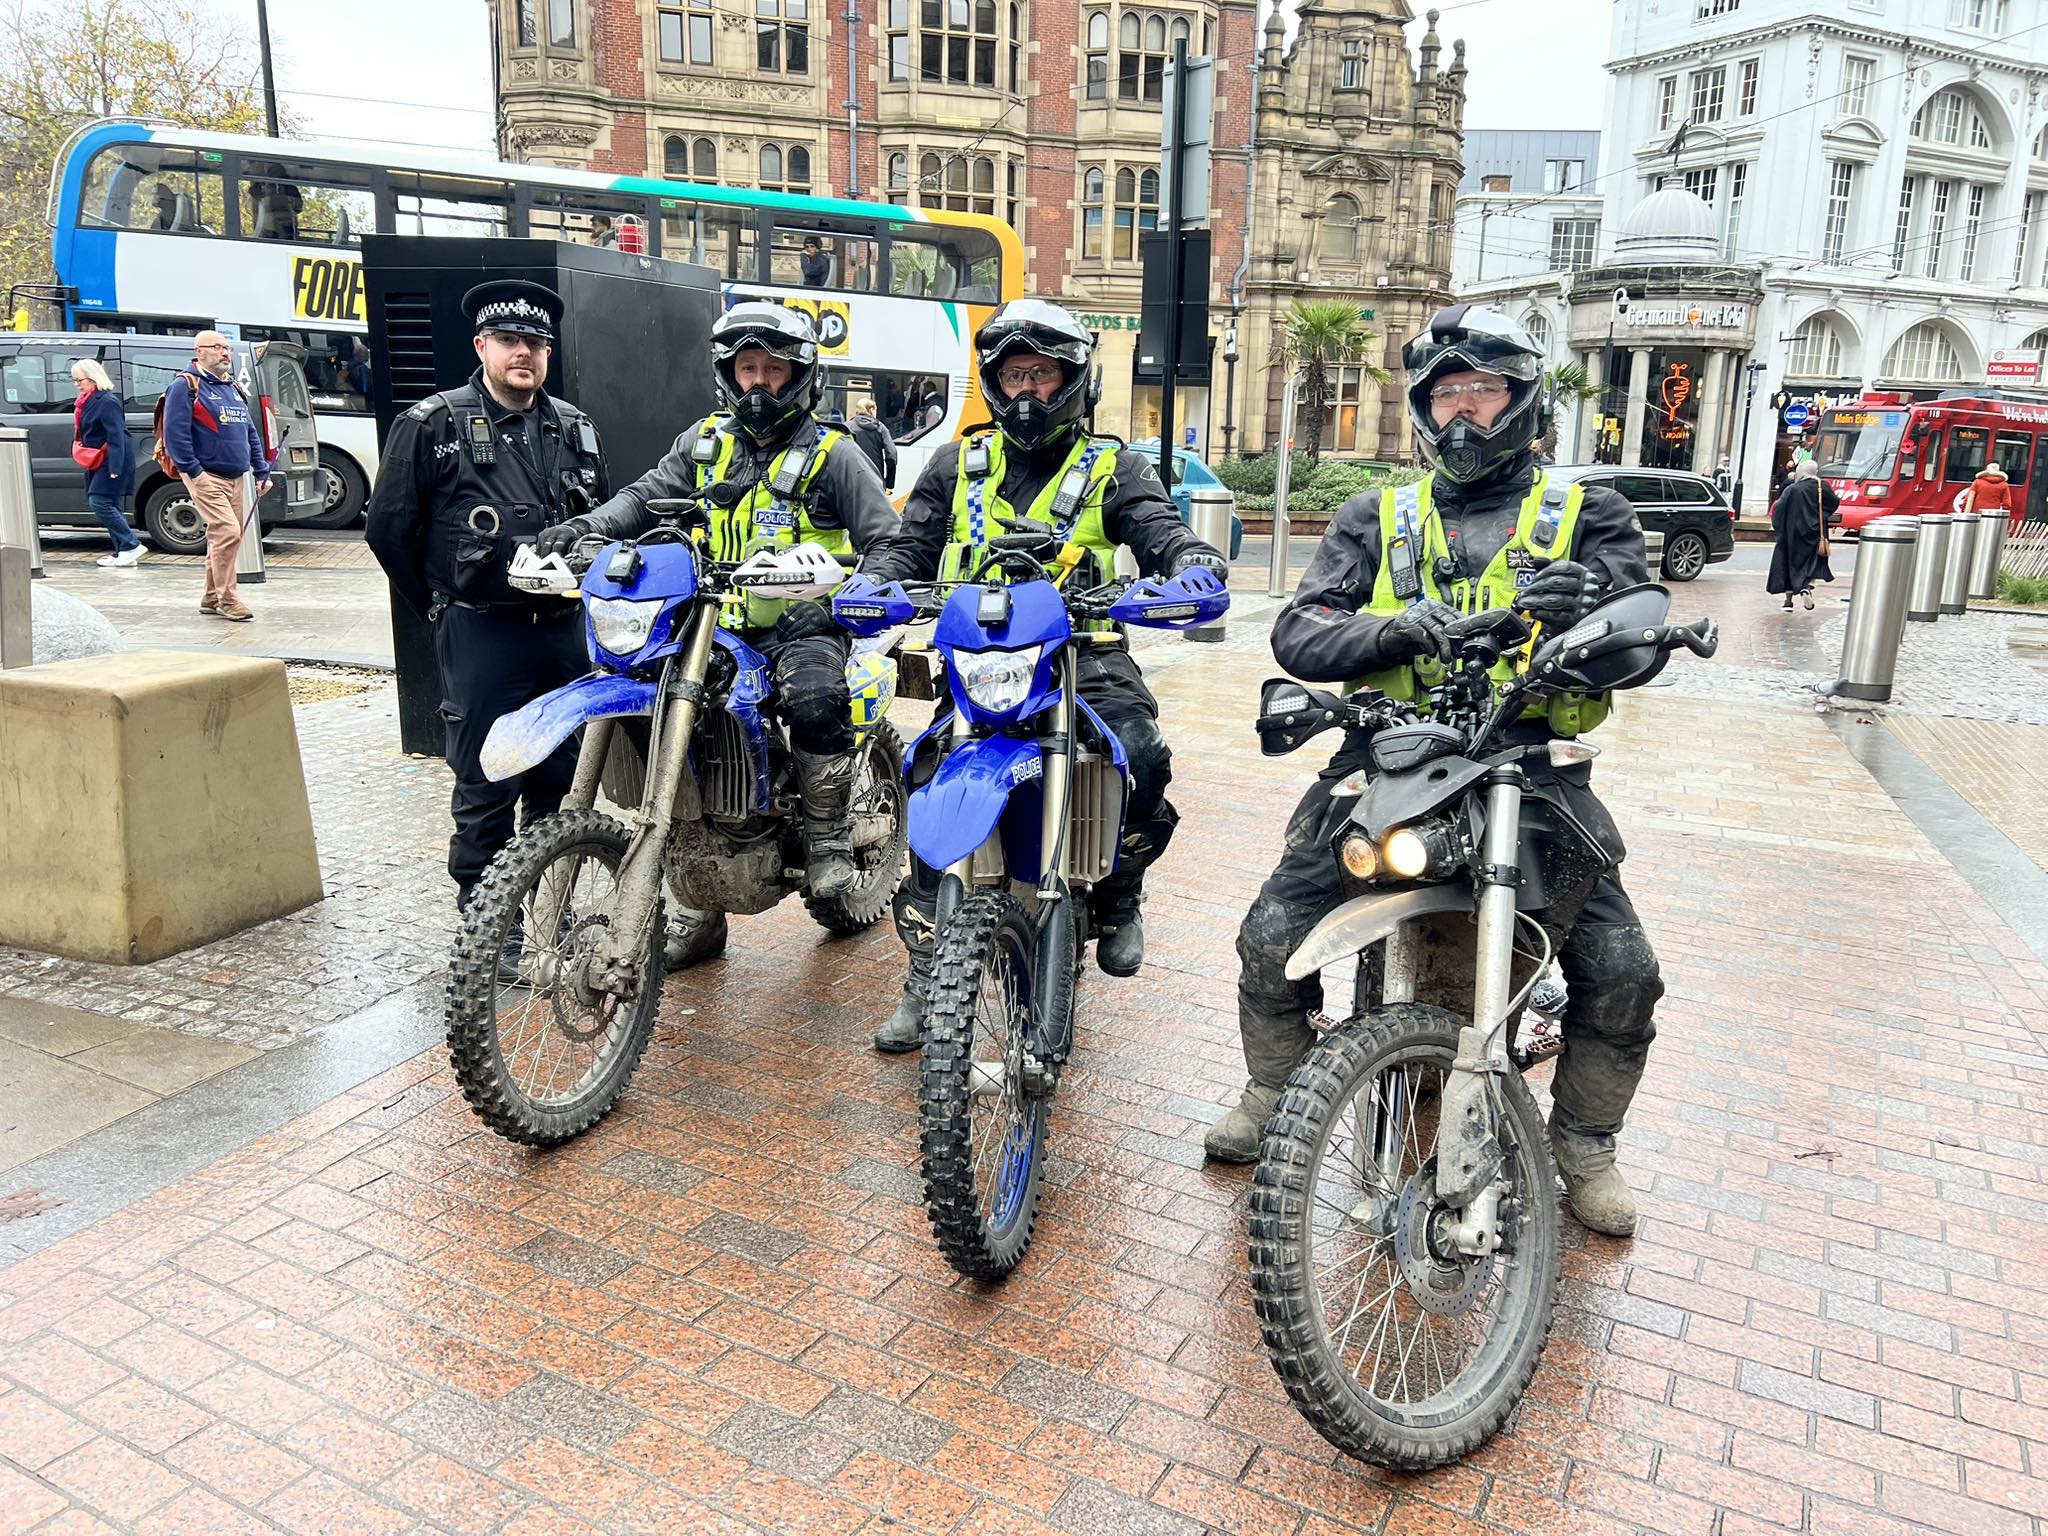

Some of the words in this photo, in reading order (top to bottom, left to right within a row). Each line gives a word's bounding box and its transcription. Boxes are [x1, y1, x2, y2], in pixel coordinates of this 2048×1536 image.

[1080, 313, 1121, 330] OYDS
[1626, 305, 1678, 327] German
[238, 353, 252, 397] TAX
[1989, 365, 2013, 373] Offices
[2014, 365, 2022, 373] To
[757, 512, 792, 526] POLICE
[1011, 756, 1041, 785] POLICE
